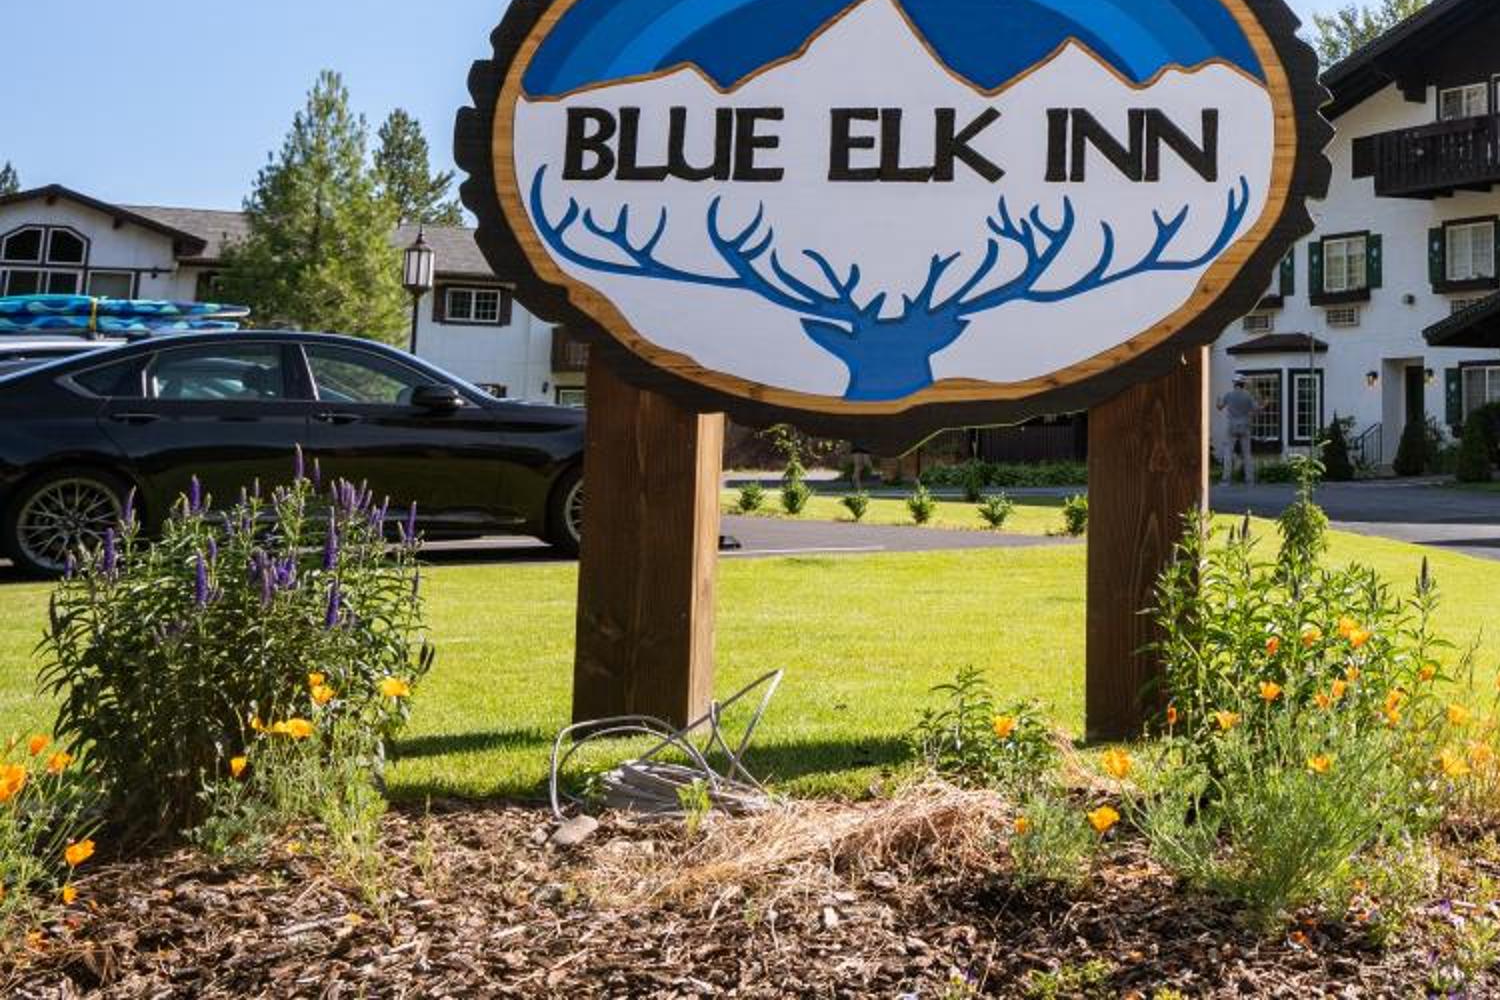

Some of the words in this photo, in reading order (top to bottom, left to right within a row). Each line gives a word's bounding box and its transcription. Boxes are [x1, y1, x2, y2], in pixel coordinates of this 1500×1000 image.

[562, 107, 785, 181] BLUE
[828, 107, 1005, 183] ELK
[1045, 108, 1218, 183] INN
